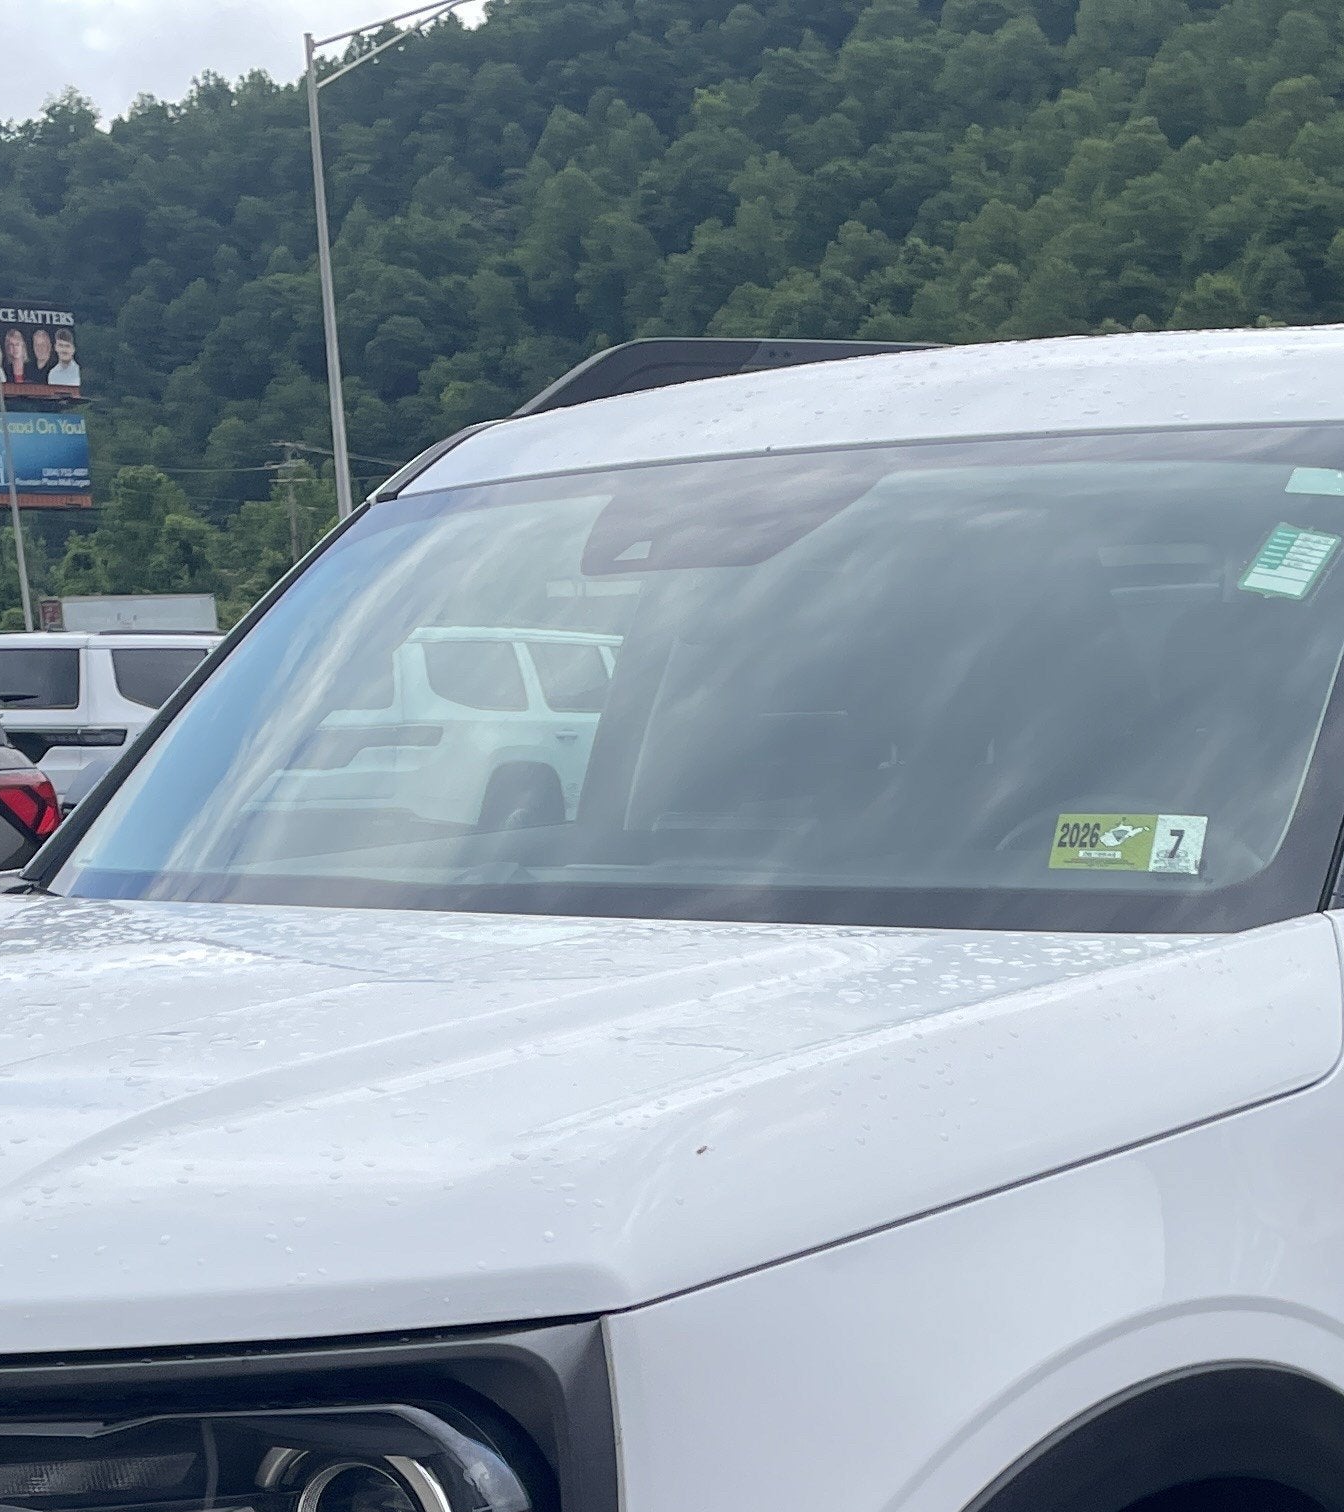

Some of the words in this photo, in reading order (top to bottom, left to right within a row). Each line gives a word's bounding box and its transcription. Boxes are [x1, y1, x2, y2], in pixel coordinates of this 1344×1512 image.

[17, 309, 75, 326] MATTERS
[36, 418, 57, 434] On
[1057, 822, 1102, 848] 2026
[1168, 829, 1186, 859] 7
